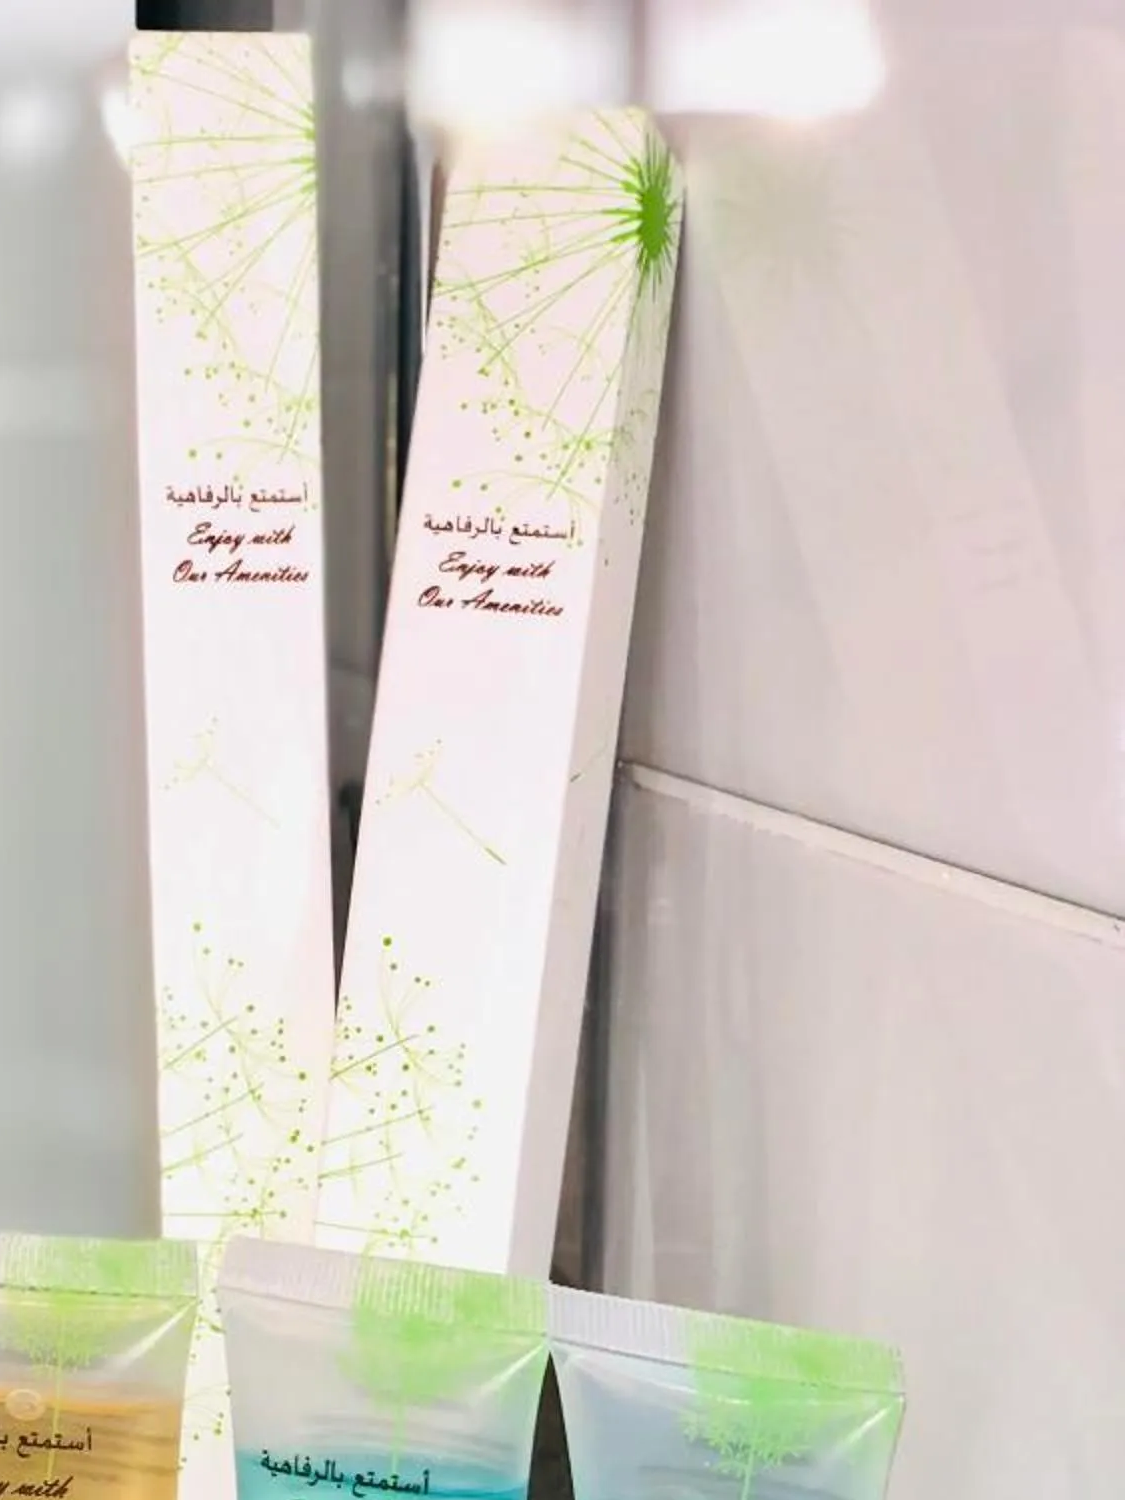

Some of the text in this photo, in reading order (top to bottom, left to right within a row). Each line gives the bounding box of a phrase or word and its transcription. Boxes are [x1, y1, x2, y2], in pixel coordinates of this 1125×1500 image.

[165, 484, 243, 509] بالرفاهية
[187, 521, 296, 554] Enjoy with
[423, 514, 503, 539] بالرفاهية
[173, 558, 310, 583] Our Amenities
[438, 551, 556, 583] Enjoy with
[417, 585, 564, 617] Our Amenities
[260, 1450, 345, 1491] بالرفاهية
[11, 1475, 75, 1499] with
